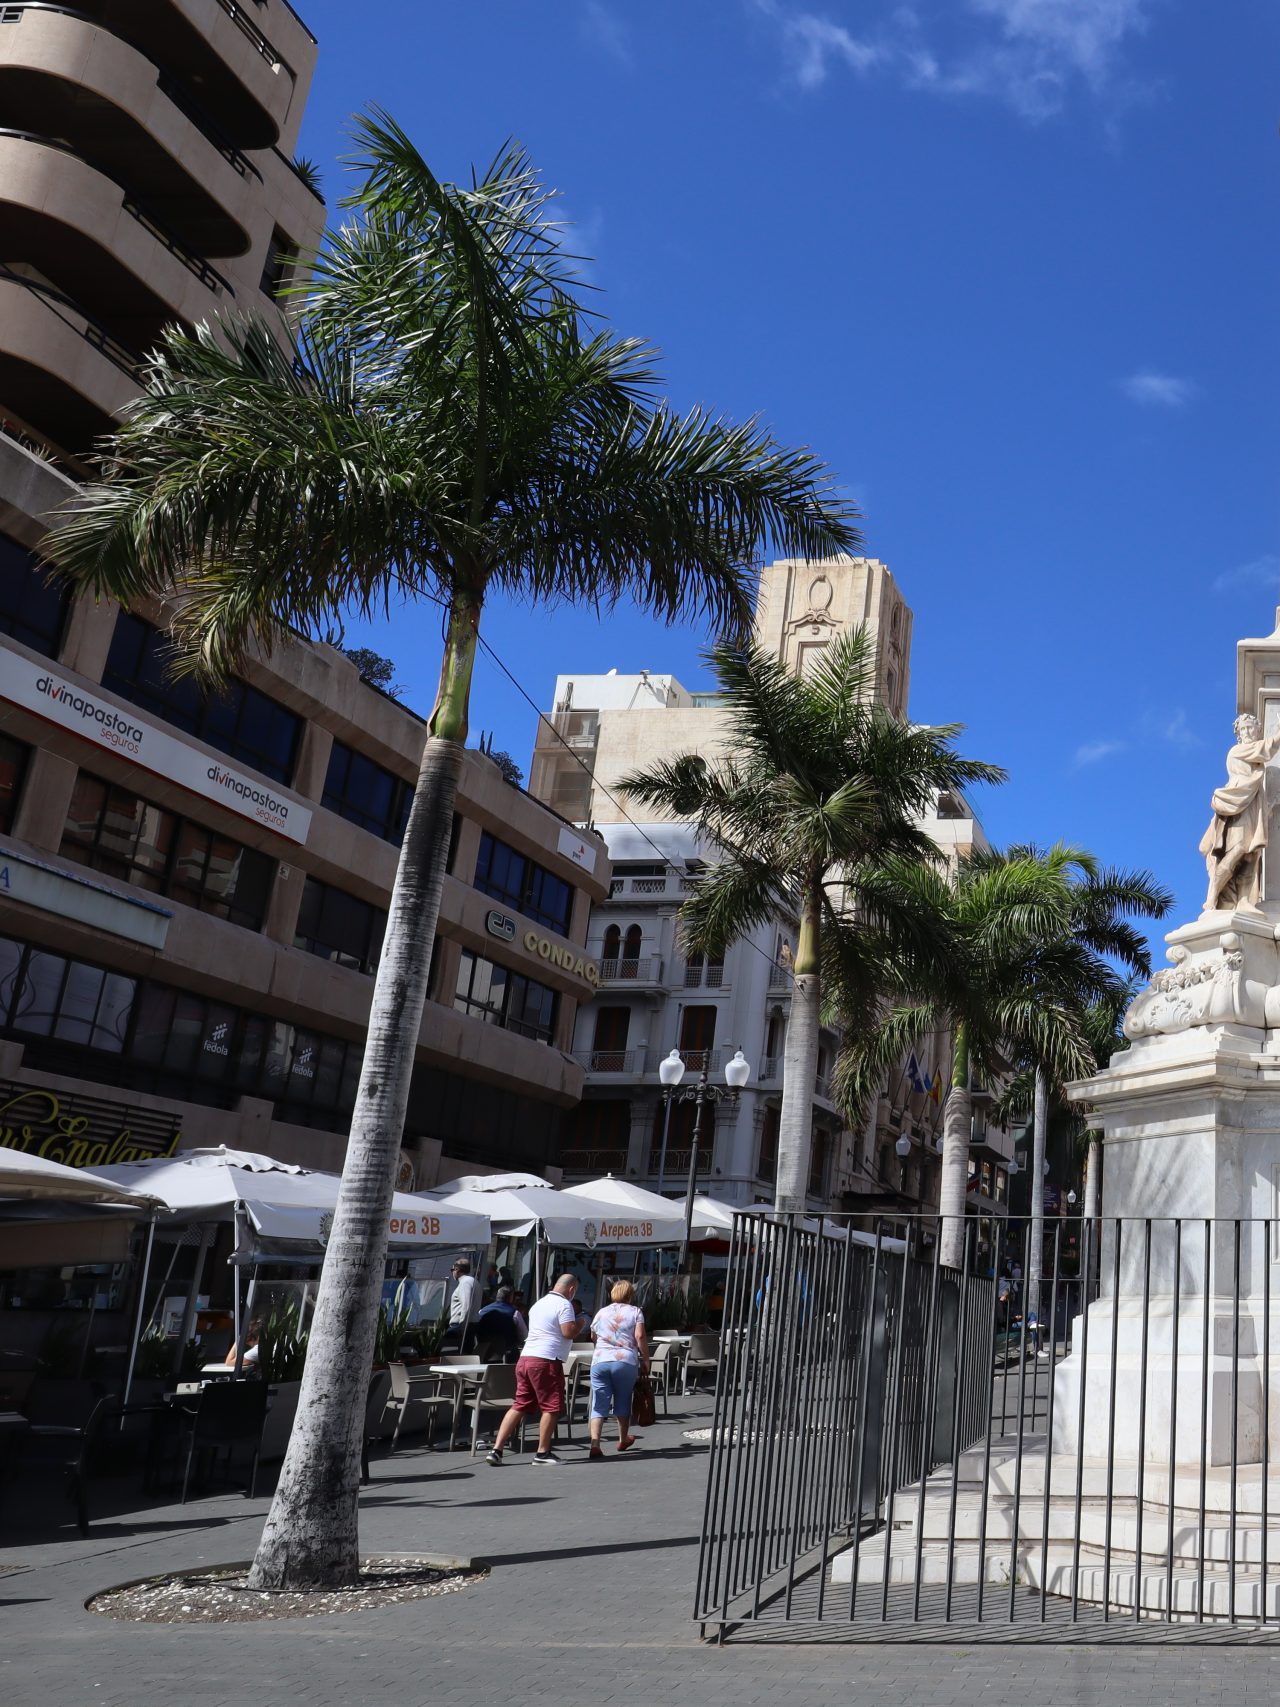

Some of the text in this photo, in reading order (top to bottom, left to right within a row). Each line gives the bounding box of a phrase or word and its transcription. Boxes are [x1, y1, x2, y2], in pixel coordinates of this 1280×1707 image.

[36, 676, 143, 743] divinapastora
[100, 727, 139, 754] seguros
[207, 766, 289, 819] divinapastora
[255, 806, 286, 828] seguros
[203, 1040, 229, 1056] fedola
[292, 1063, 314, 1078] fedola
[38, 1116, 182, 1168] England
[389, 1216, 441, 1236] era 3B
[600, 1221, 653, 1240] Arepera 3B
